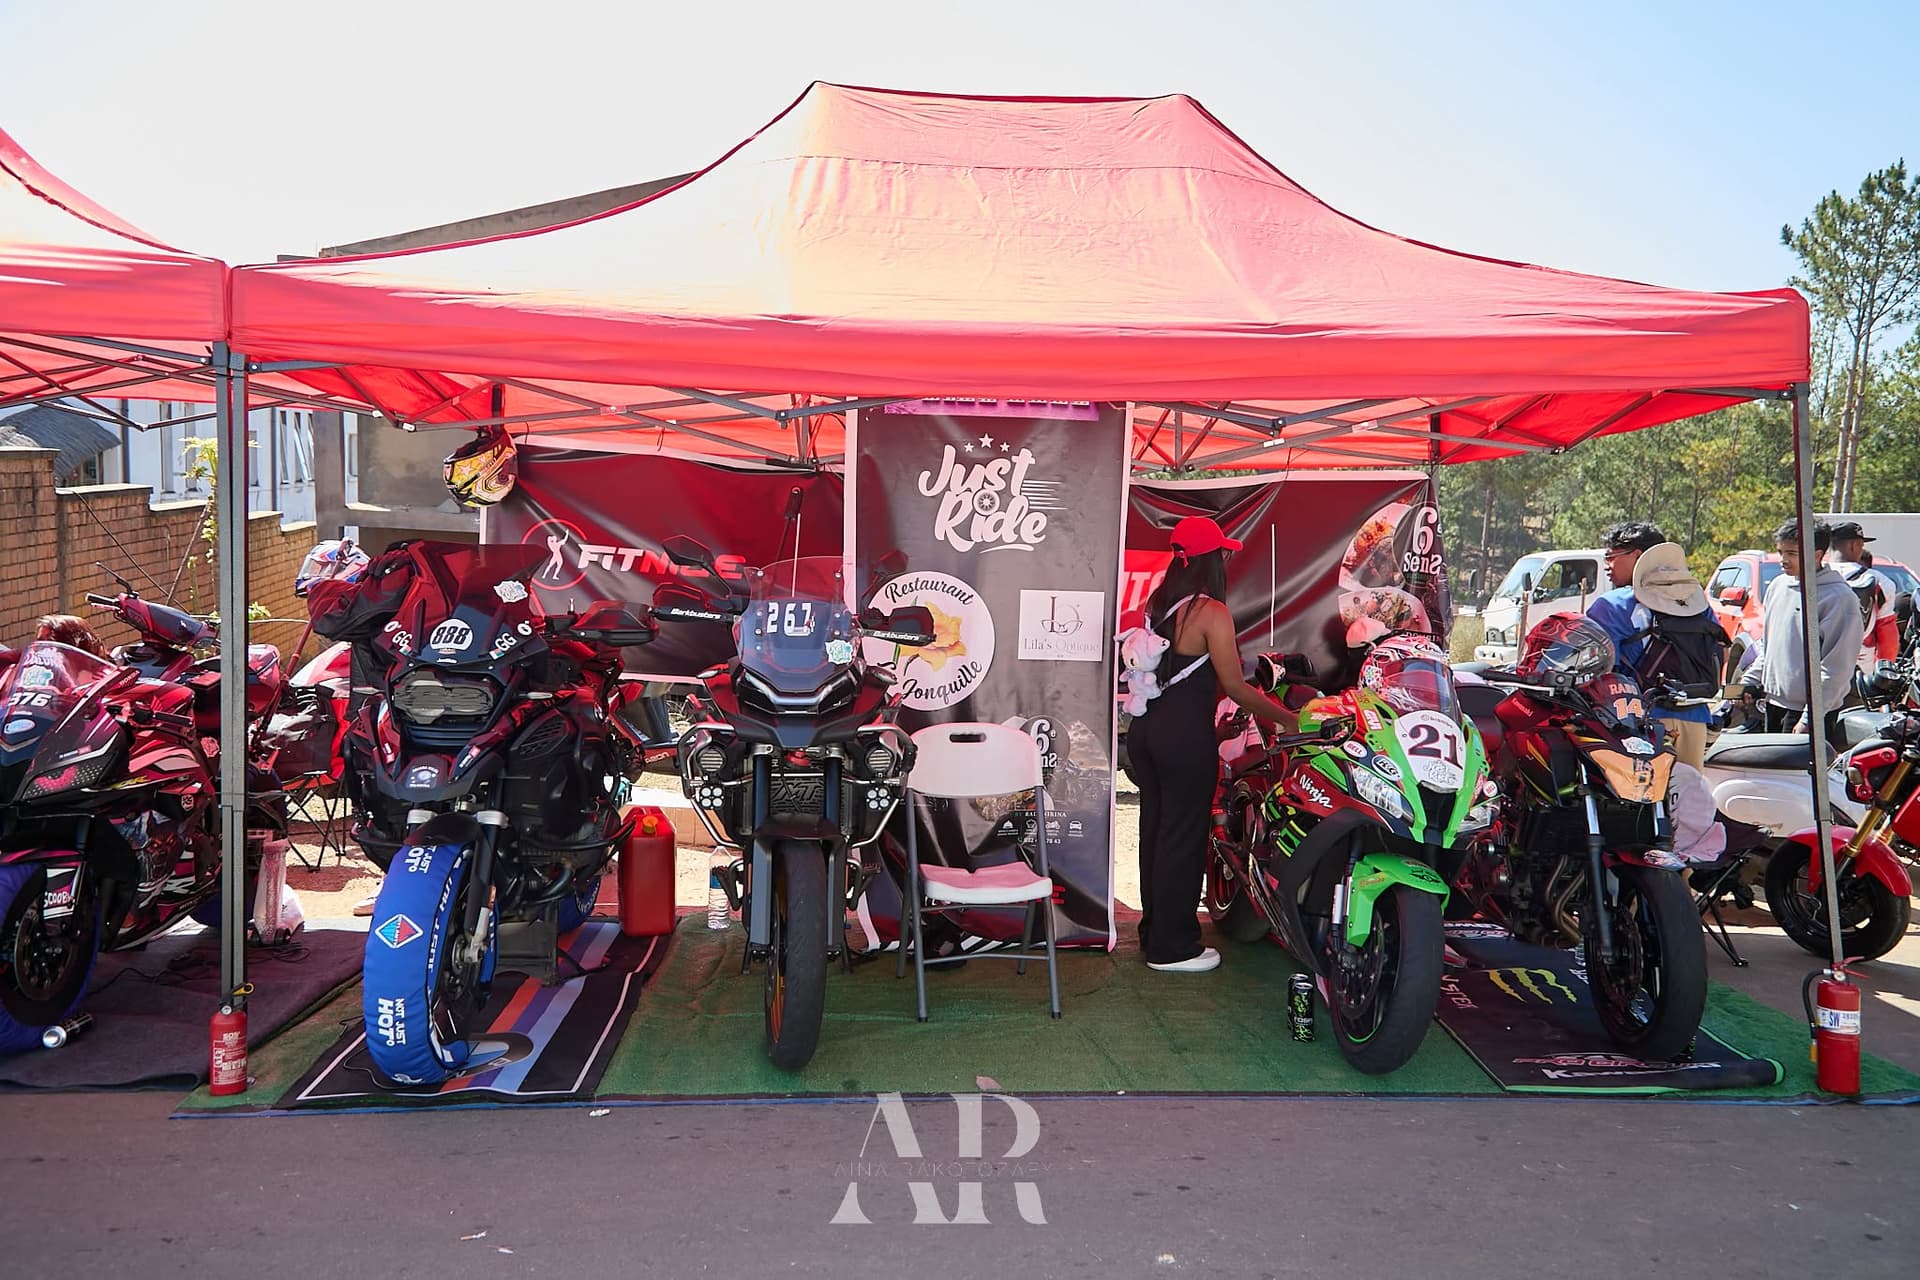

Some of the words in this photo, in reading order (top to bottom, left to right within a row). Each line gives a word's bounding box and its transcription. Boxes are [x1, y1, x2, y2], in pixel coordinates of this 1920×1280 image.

[918, 444, 1036, 497] Just
[934, 490, 1048, 552] Ride
[885, 578, 974, 605] Restaurant
[671, 608, 721, 619] Barkbusters
[432, 626, 470, 645] 888
[495, 633, 517, 651] GG
[873, 630, 920, 641] Barkbusters
[1024, 637, 1052, 651] Lila's
[902, 661, 982, 704] Jonquille
[1613, 697, 1646, 720] 14
[1346, 743, 1363, 755] BELL
[1408, 724, 1463, 770] 21
[1300, 774, 1333, 809] Ninja
[395, 998, 405, 1018] NOT
[395, 1021, 406, 1045] JUST
